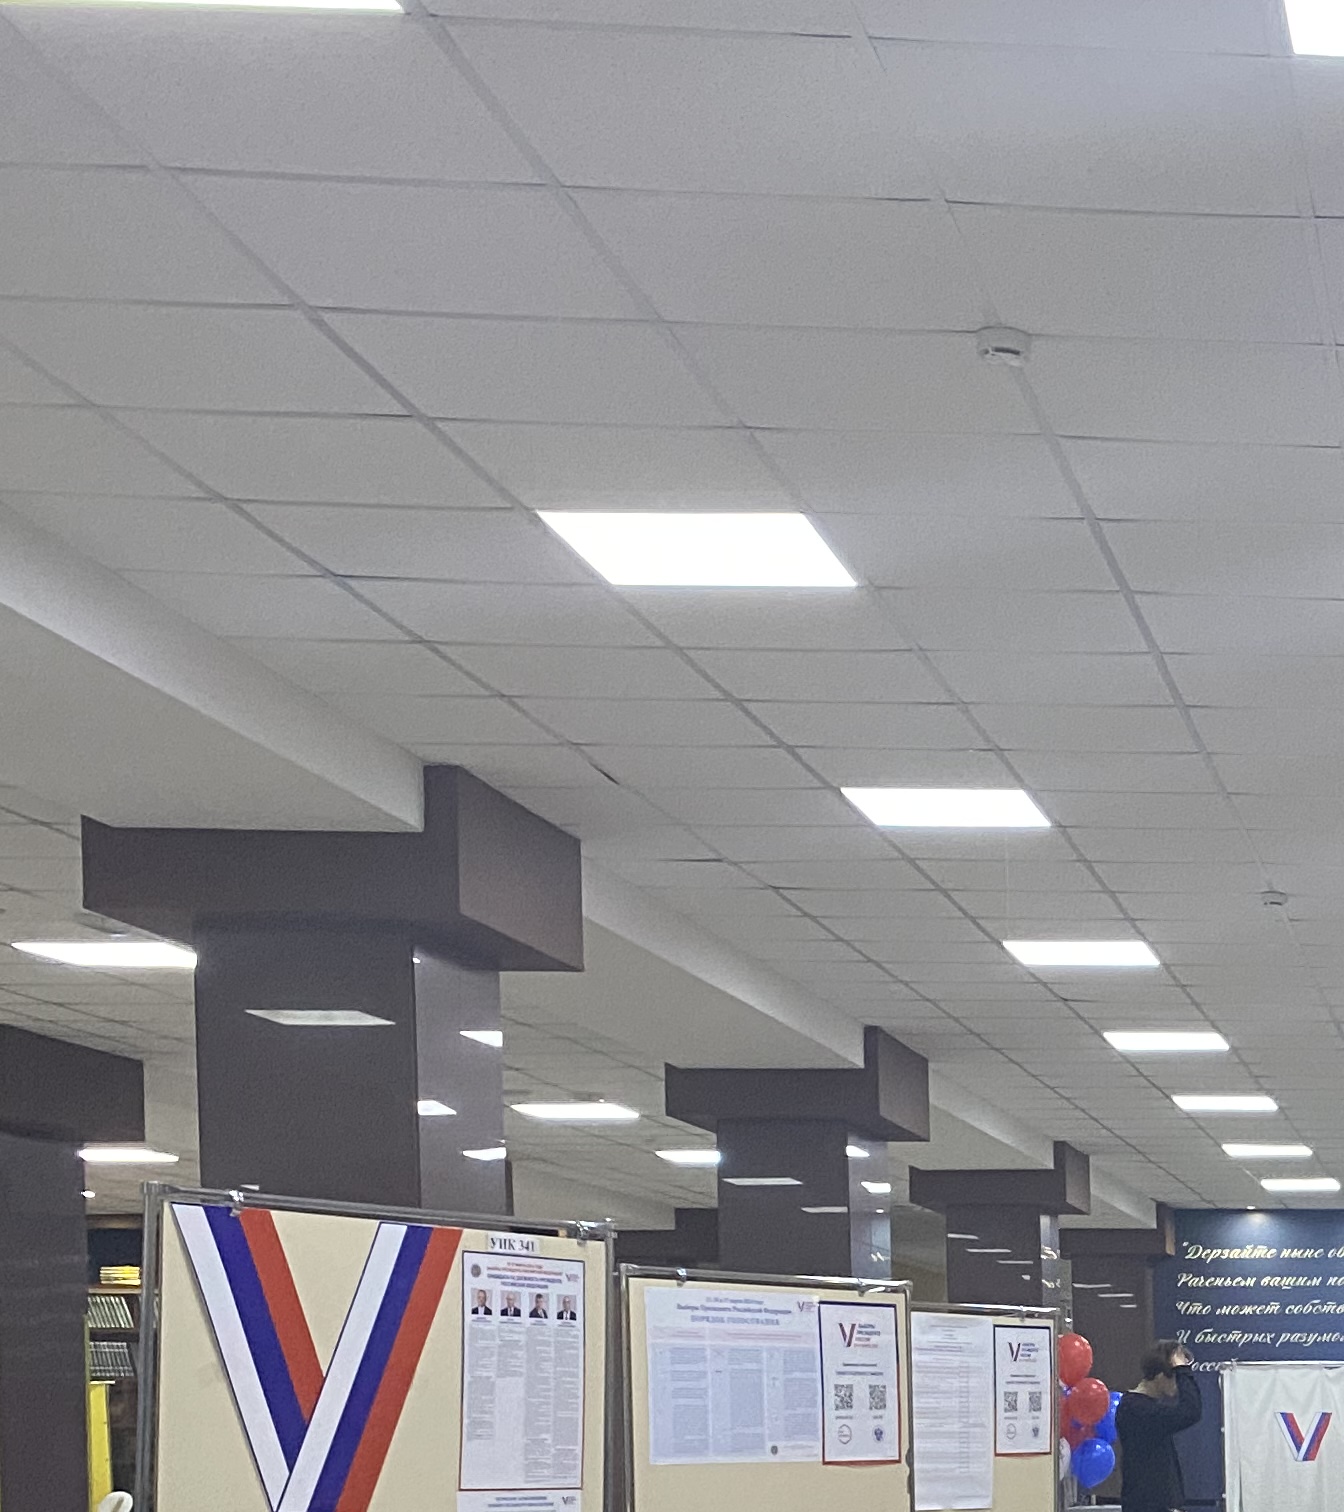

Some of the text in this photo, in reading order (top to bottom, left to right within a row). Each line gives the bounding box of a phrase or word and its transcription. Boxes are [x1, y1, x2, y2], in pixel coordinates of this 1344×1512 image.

[1260, 1275, 1323, 1290] вашим
[1175, 1300, 1212, 1316] Что
[1215, 1301, 1281, 1316] может
[1194, 1327, 1276, 1348] быстрых
